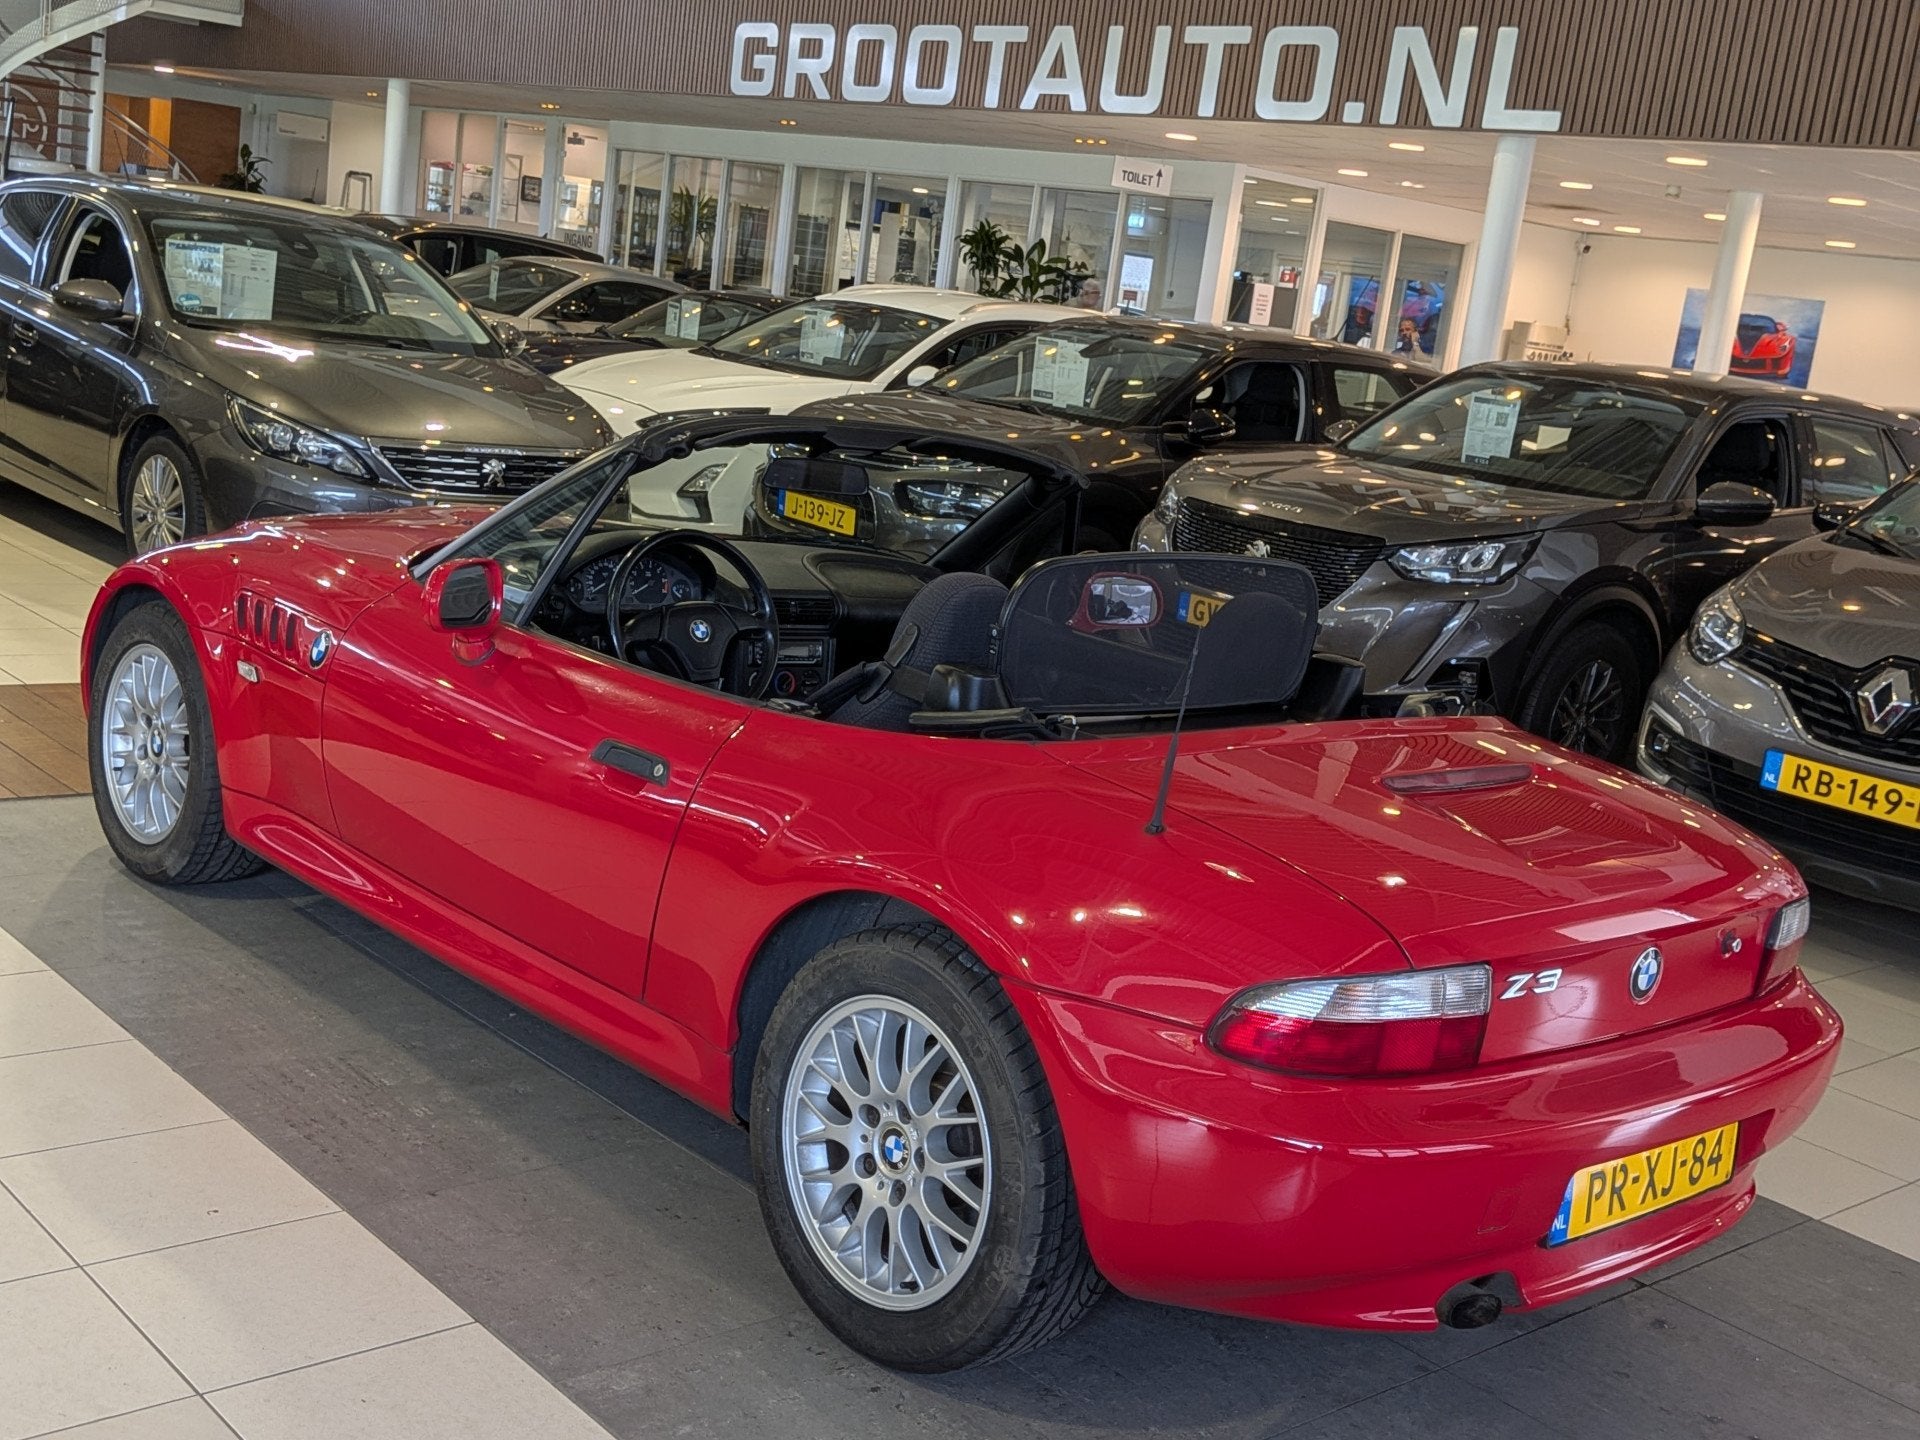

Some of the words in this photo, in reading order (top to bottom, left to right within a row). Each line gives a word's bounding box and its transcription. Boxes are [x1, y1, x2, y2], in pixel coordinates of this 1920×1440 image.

[729, 21, 1563, 132] GROOTAUTO.NL
[1121, 169, 1154, 187] TOILET
[563, 232, 593, 249] INGANG
[791, 497, 846, 530] J-139-JZ
[1764, 772, 1777, 784] NL
[1791, 763, 1920, 824] RB-149-
[1499, 967, 1563, 1000] Z3
[1584, 1129, 1725, 1224] PR-XJ-84
[1551, 1213, 1567, 1233] NL
